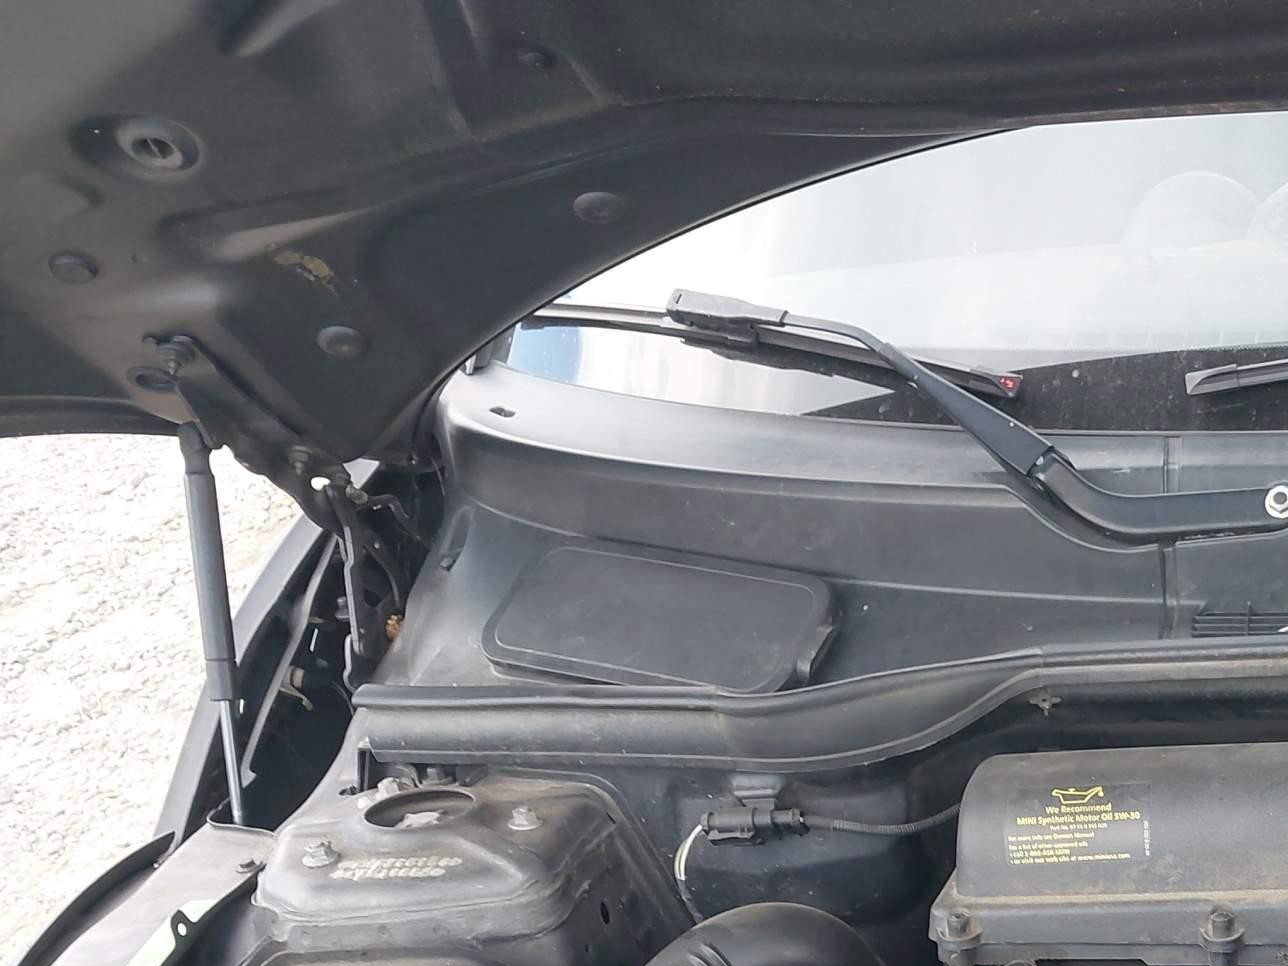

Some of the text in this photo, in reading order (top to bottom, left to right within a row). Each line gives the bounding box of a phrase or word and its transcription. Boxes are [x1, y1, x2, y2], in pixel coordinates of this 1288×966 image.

[1045, 803, 1112, 814] We Recommend
[1016, 812, 1140, 826] MINI Synthetic Motor Oil 5W-30
